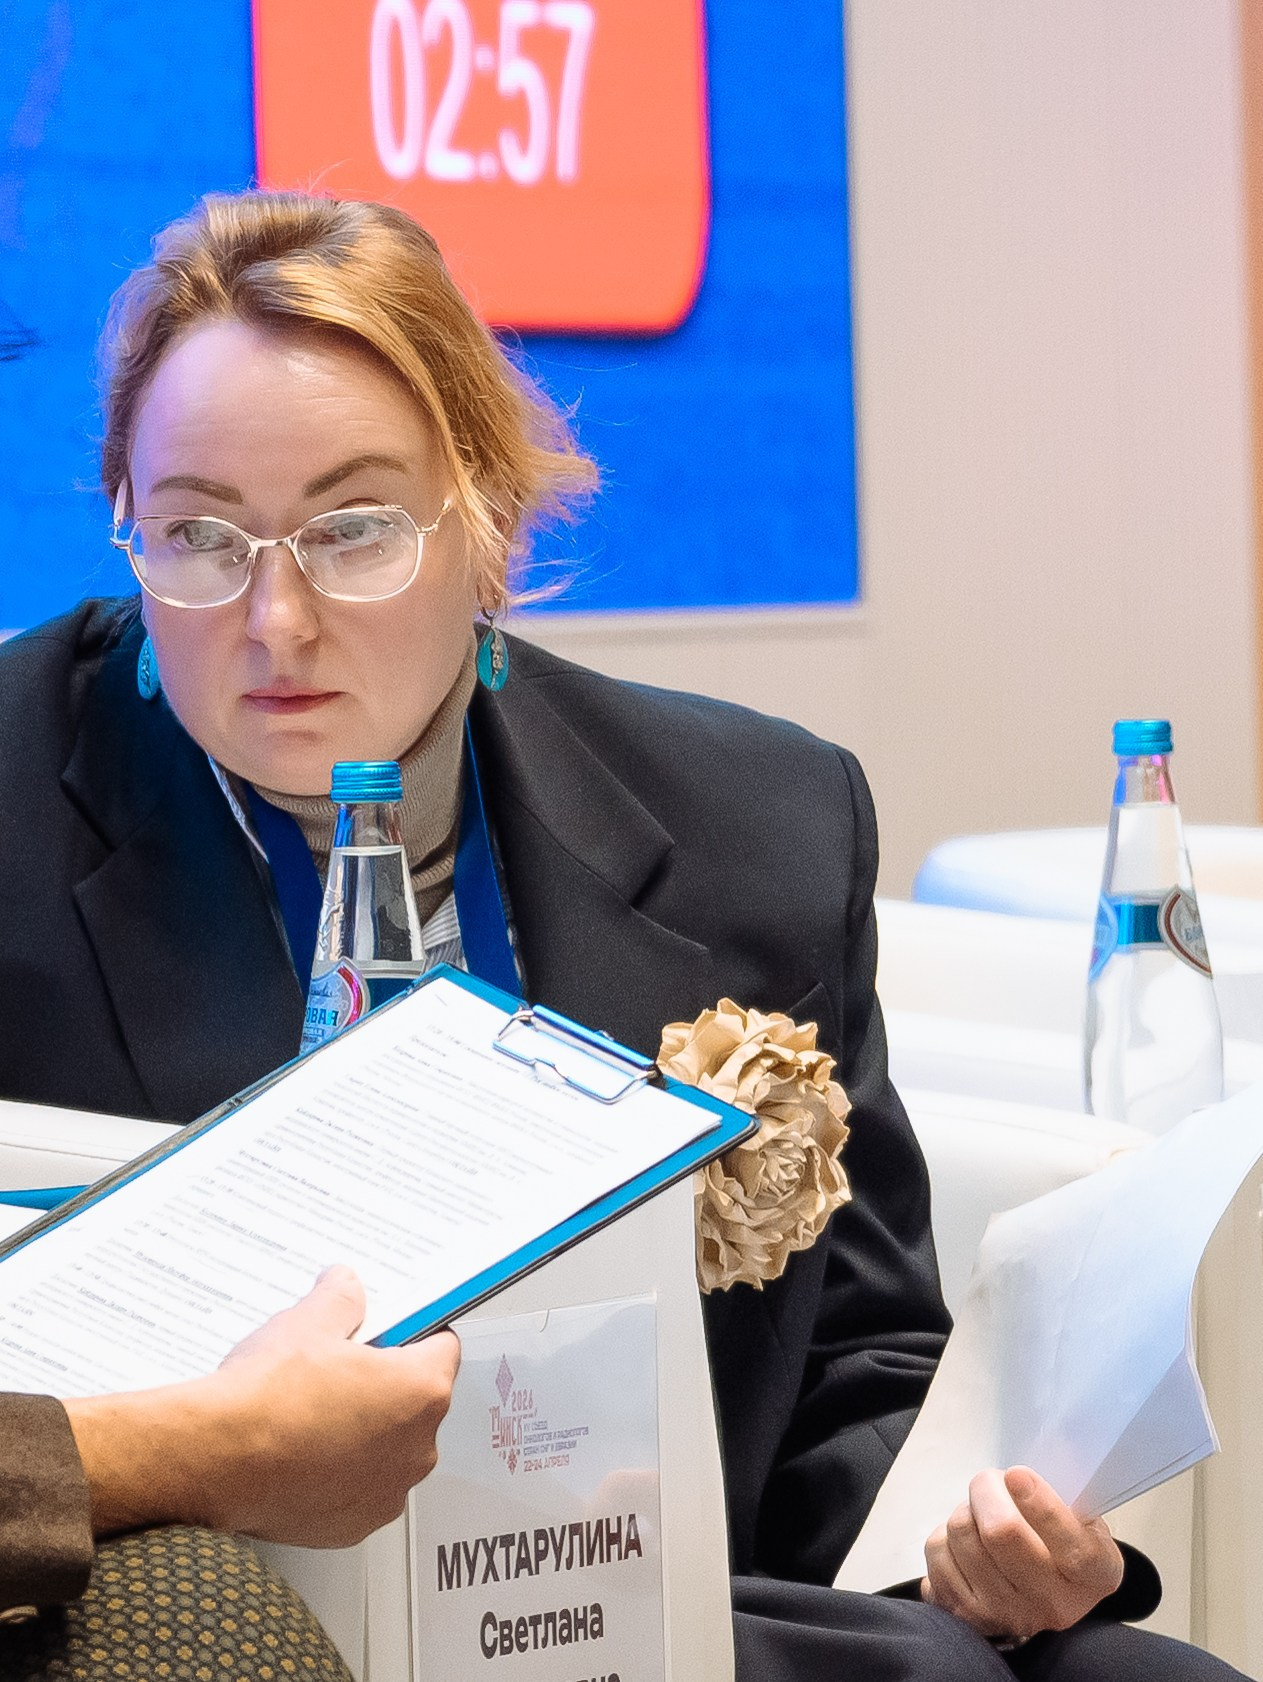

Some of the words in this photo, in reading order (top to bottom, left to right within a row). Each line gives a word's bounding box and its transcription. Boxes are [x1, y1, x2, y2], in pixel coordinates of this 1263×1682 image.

[370, 0, 595, 184] 02:57
[437, 1513, 643, 1592] МУХТАРУЛИНА
[479, 1602, 604, 1660] Светлана
